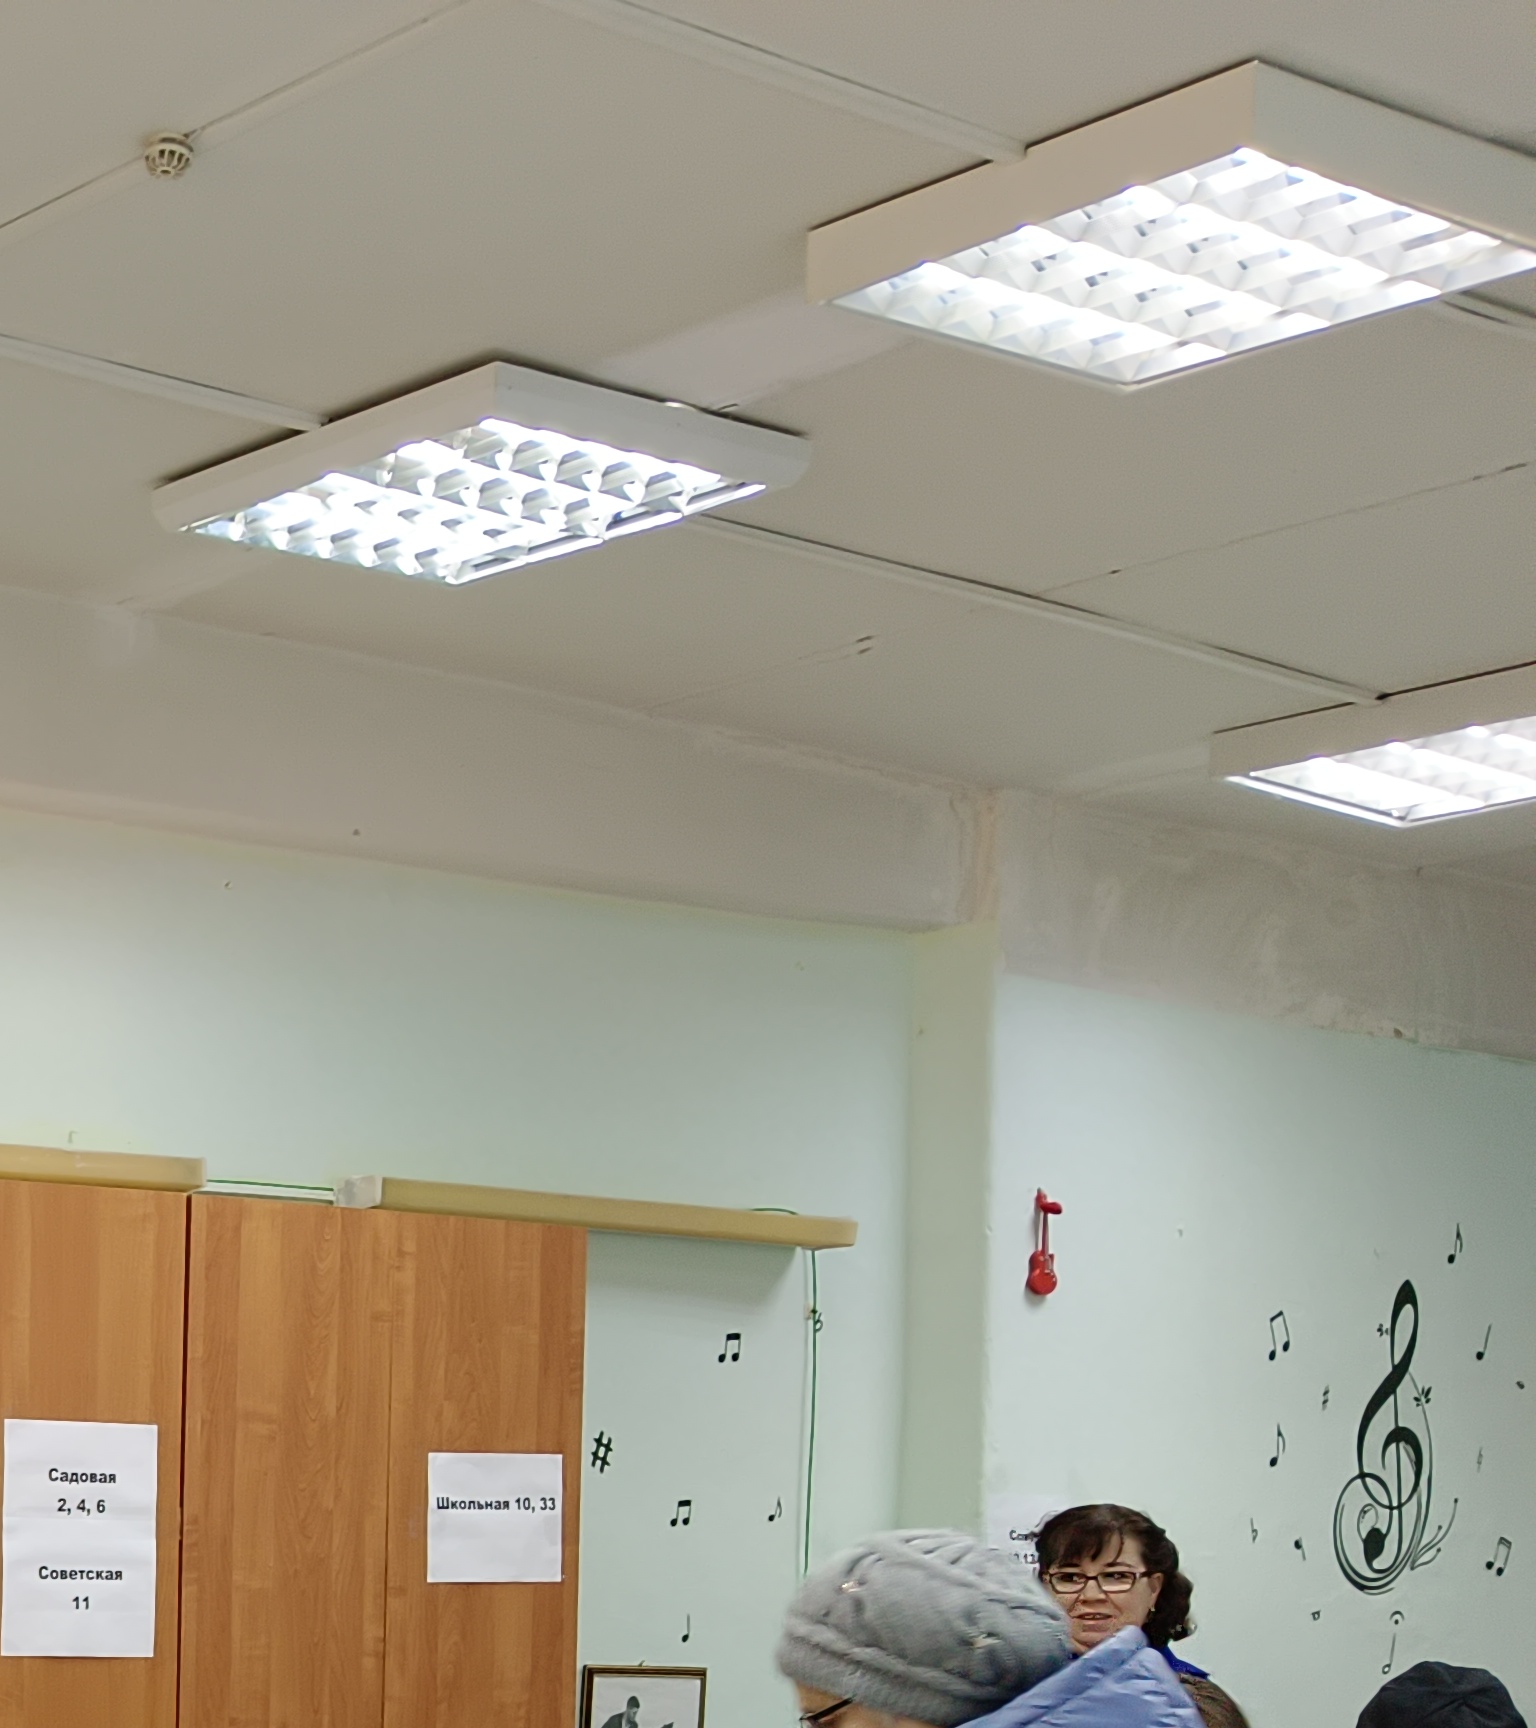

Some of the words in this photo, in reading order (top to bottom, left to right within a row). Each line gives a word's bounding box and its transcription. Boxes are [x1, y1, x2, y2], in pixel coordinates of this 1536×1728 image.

[48, 1468, 117, 1485] Садовая
[57, 1498, 72, 1516] 2,
[76, 1498, 91, 1516] 4,
[96, 1499, 106, 1513] 6
[436, 1496, 510, 1511] Школьная
[515, 1497, 536, 1513] 10,
[540, 1497, 556, 1511] 33
[38, 1566, 123, 1581] Советская
[72, 1596, 90, 1610] 11
